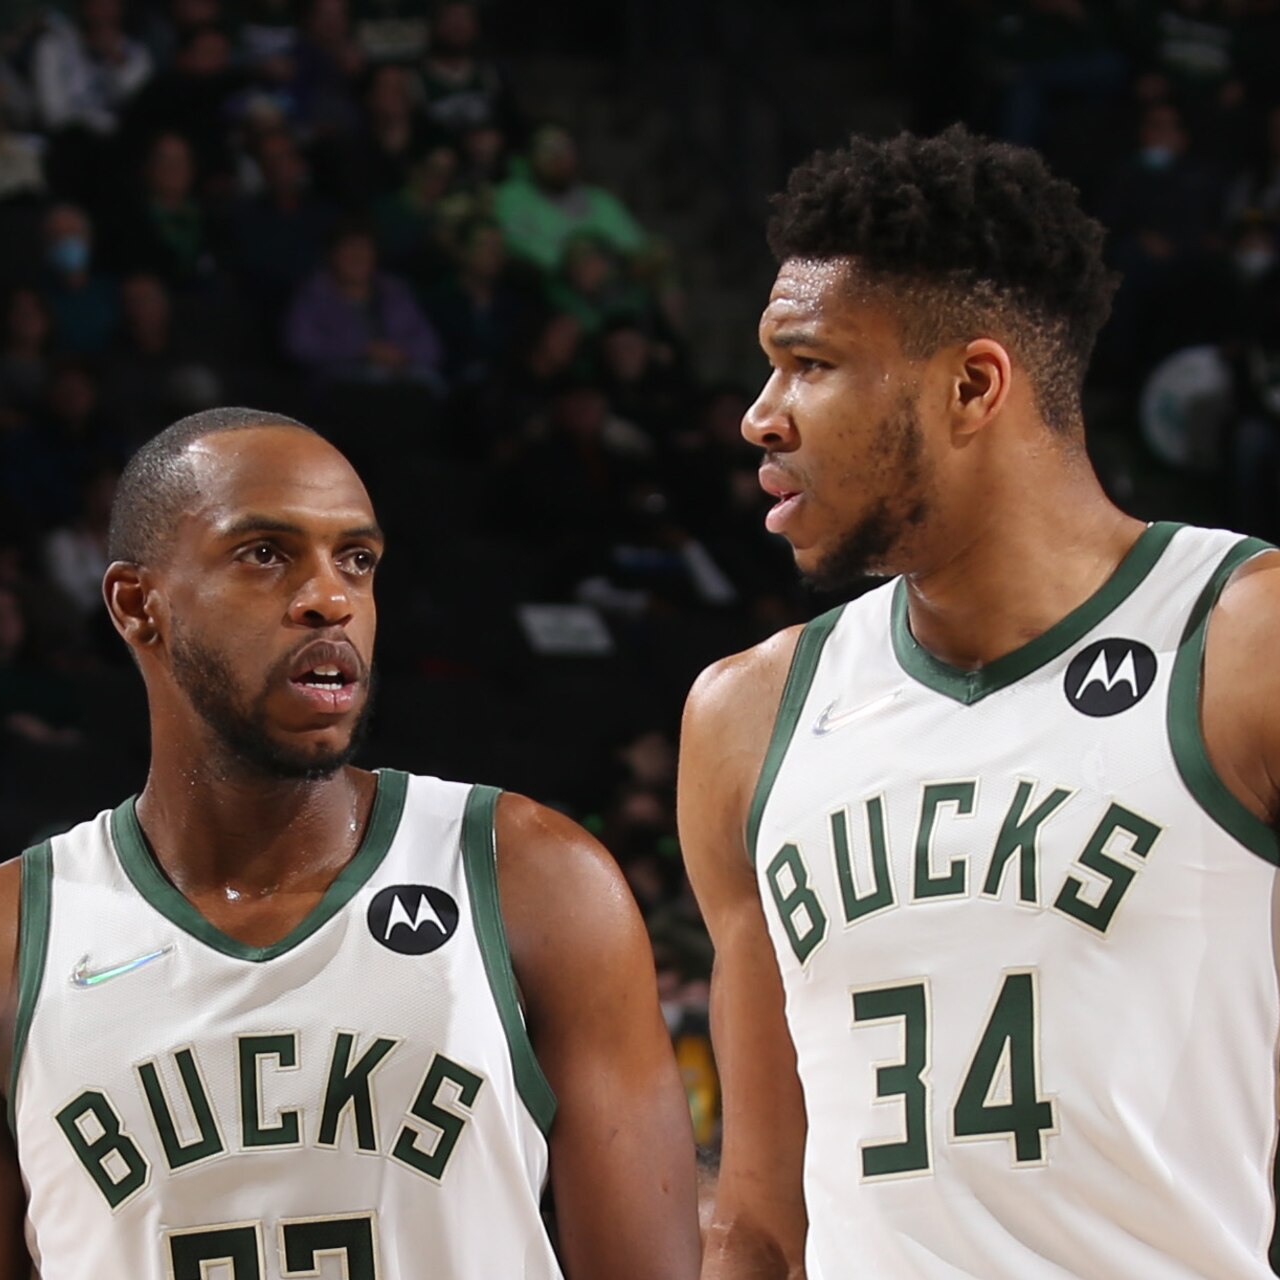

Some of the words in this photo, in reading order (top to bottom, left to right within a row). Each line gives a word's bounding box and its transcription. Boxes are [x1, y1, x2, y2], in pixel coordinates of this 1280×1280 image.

[762, 776, 1165, 970] BUCKS
[53, 1029, 485, 1212] BUCKS
[847, 966, 1060, 1184] 34
